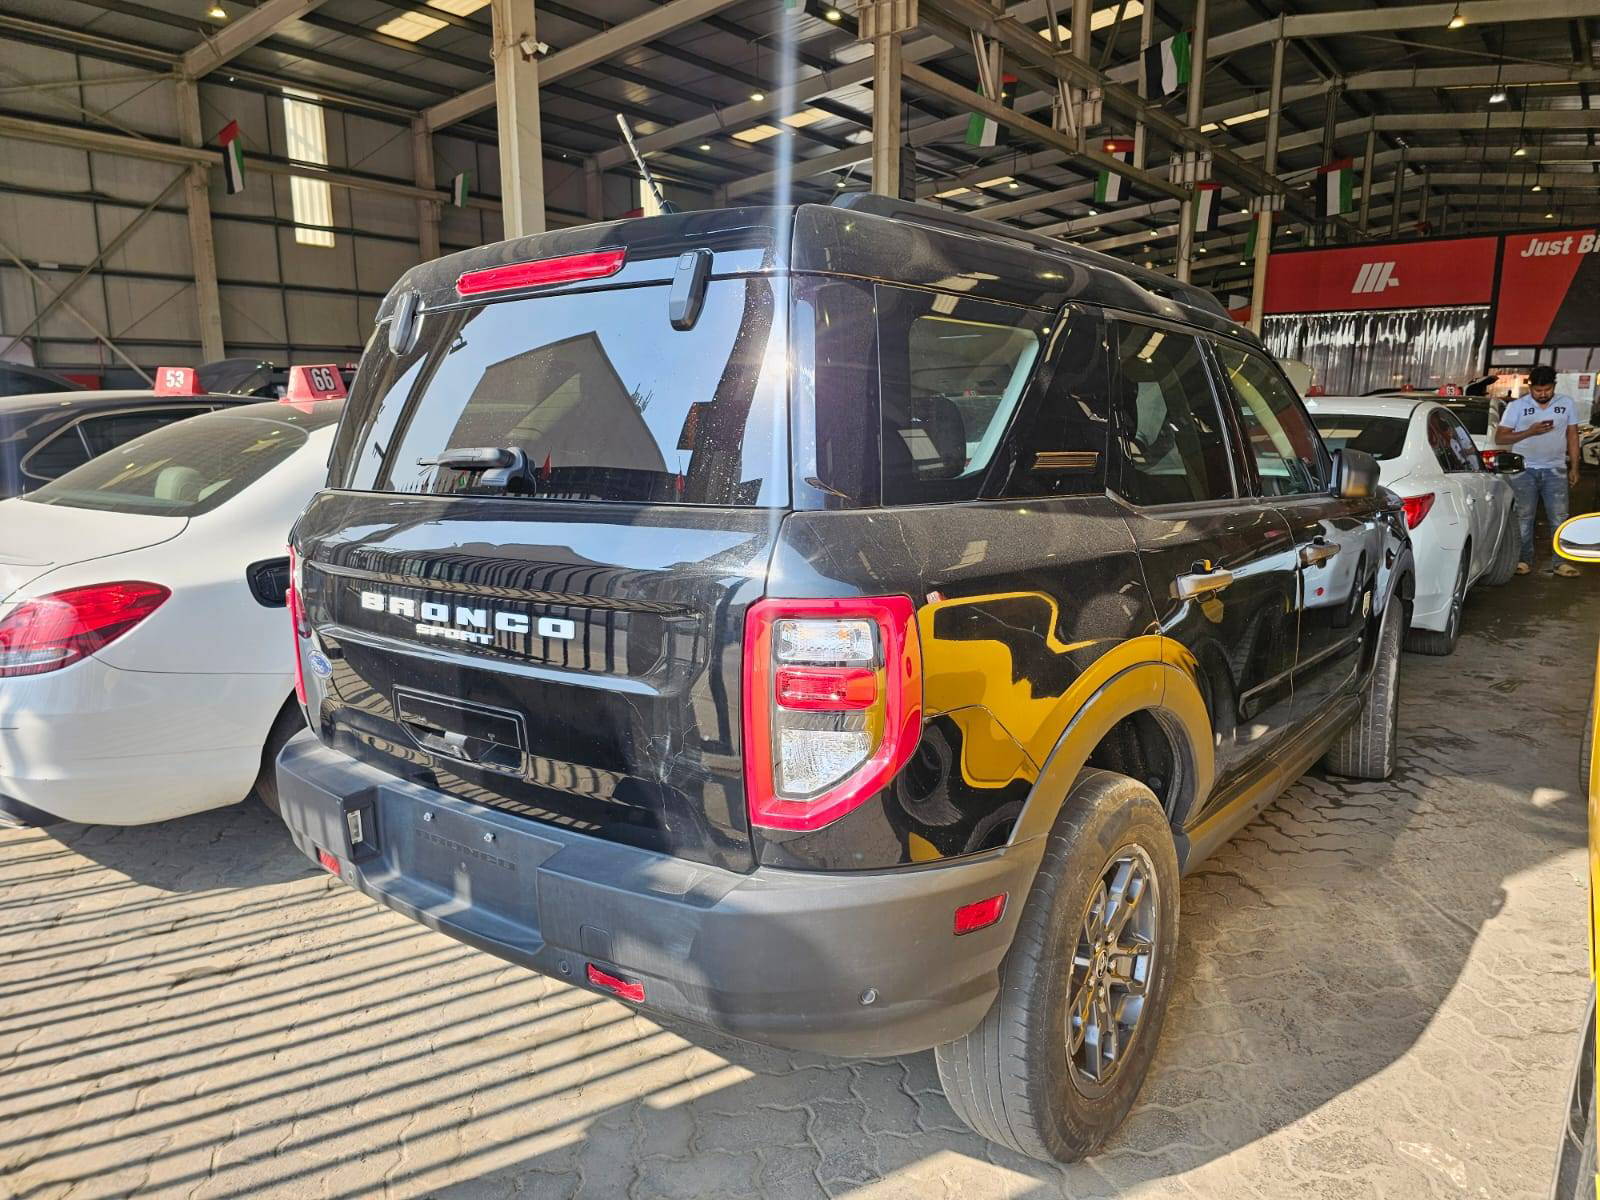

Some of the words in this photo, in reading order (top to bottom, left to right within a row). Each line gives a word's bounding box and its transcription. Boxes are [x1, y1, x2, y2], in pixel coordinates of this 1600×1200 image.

[1521, 236, 1573, 257] Just
[166, 370, 184, 388] 53
[311, 368, 336, 391] 66
[1523, 407, 1535, 416] 19
[1554, 406, 1567, 414] 87
[361, 591, 575, 641] BRONCO
[416, 623, 494, 645] SPORT
